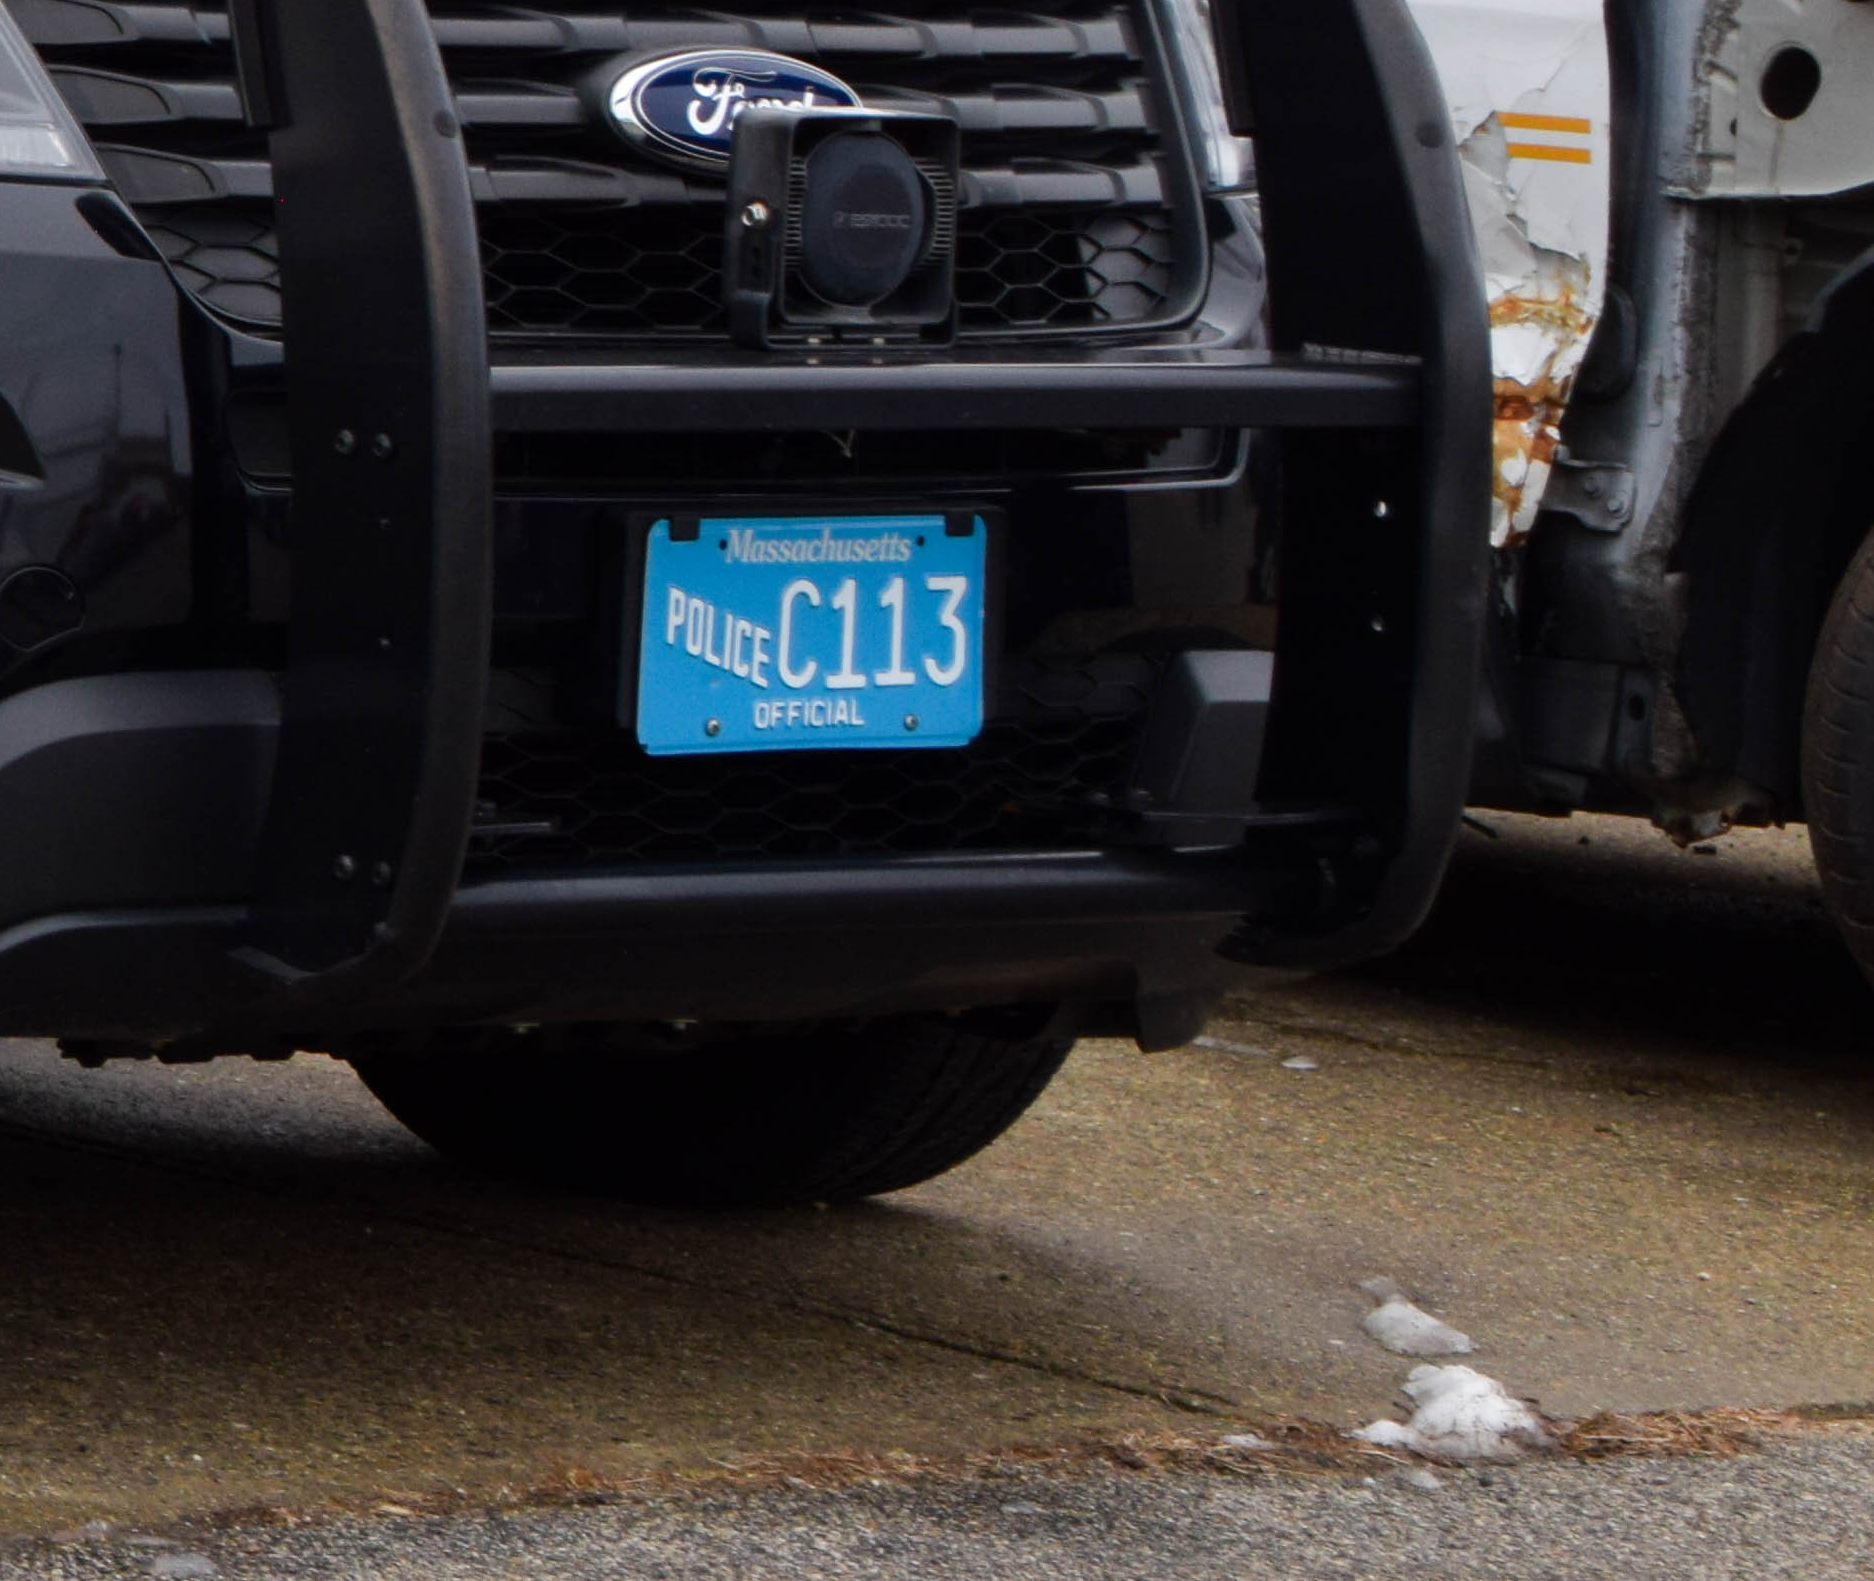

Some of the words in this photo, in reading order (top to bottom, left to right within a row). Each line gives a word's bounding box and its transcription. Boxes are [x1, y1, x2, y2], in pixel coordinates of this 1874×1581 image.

[724, 526, 912, 563] Massachusetts
[665, 586, 772, 689] POLICE
[777, 575, 968, 689] C113
[753, 698, 866, 729] OFFICIAL
